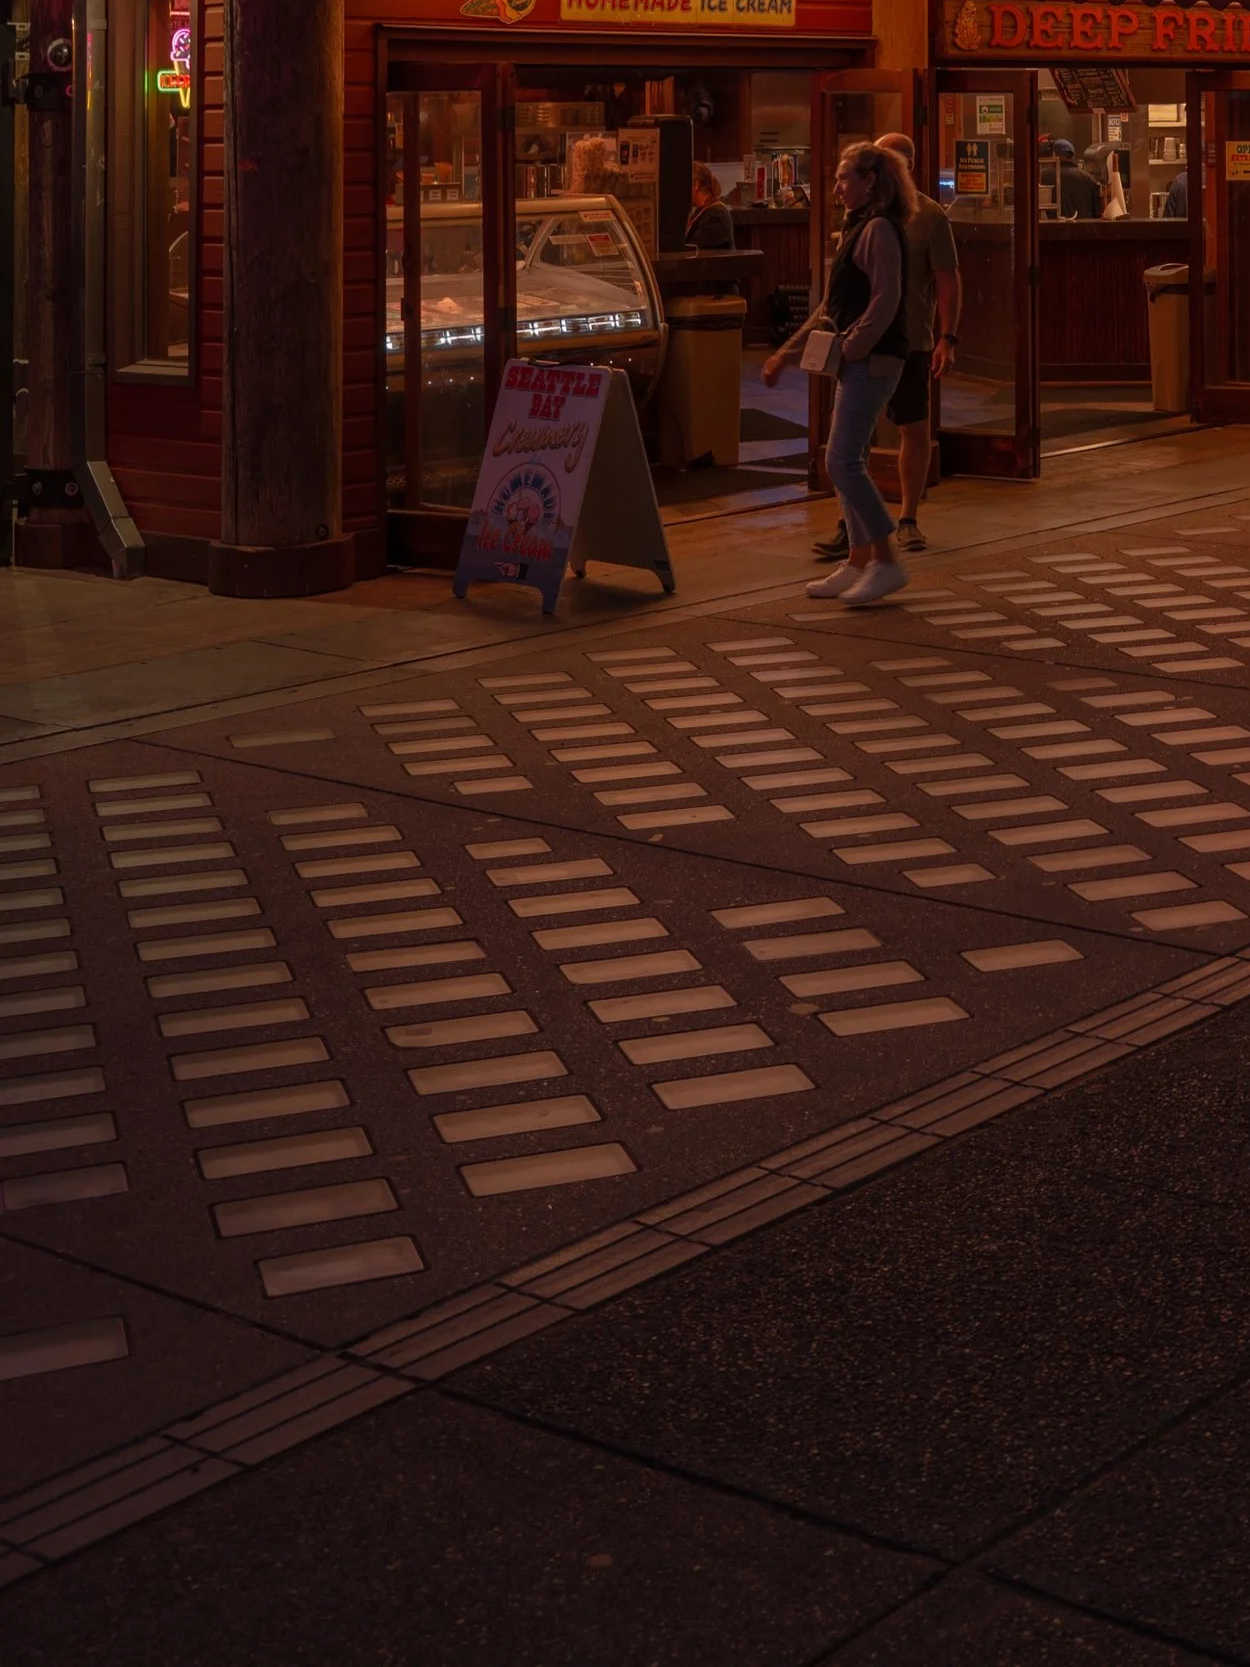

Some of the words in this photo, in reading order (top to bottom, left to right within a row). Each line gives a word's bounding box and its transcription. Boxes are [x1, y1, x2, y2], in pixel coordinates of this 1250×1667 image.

[988, 4, 1140, 50] DEEP
[504, 365, 602, 398] SEATTLE
[527, 392, 567, 422] BAY
[491, 419, 589, 474] Creamery
